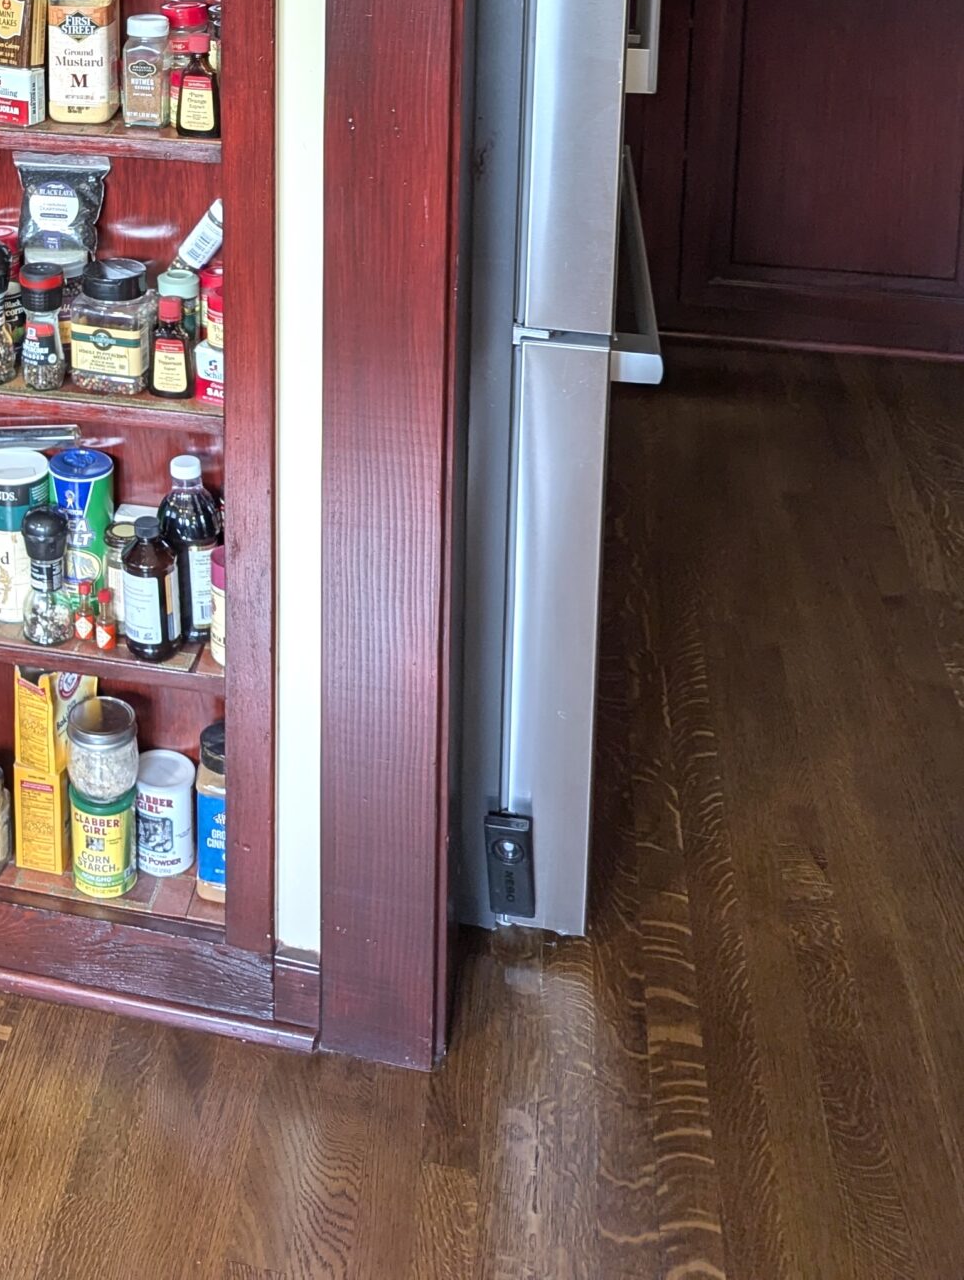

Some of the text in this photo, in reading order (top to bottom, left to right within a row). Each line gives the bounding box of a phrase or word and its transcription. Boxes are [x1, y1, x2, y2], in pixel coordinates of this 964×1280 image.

[66, 15, 92, 26] FIRST
[61, 26, 96, 36] STREET
[64, 48, 94, 57] Ground
[55, 55, 104, 68] Mustard
[70, 73, 89, 89] M
[67, 520, 88, 532] EA
[67, 533, 93, 547] ALT
[137, 800, 162, 815] GIRL
[73, 812, 120, 828] CLABBER
[82, 824, 108, 836] GIRL
[81, 850, 111, 865] CORN
[148, 857, 182, 867] POWDER
[77, 856, 116, 873] STARCH
